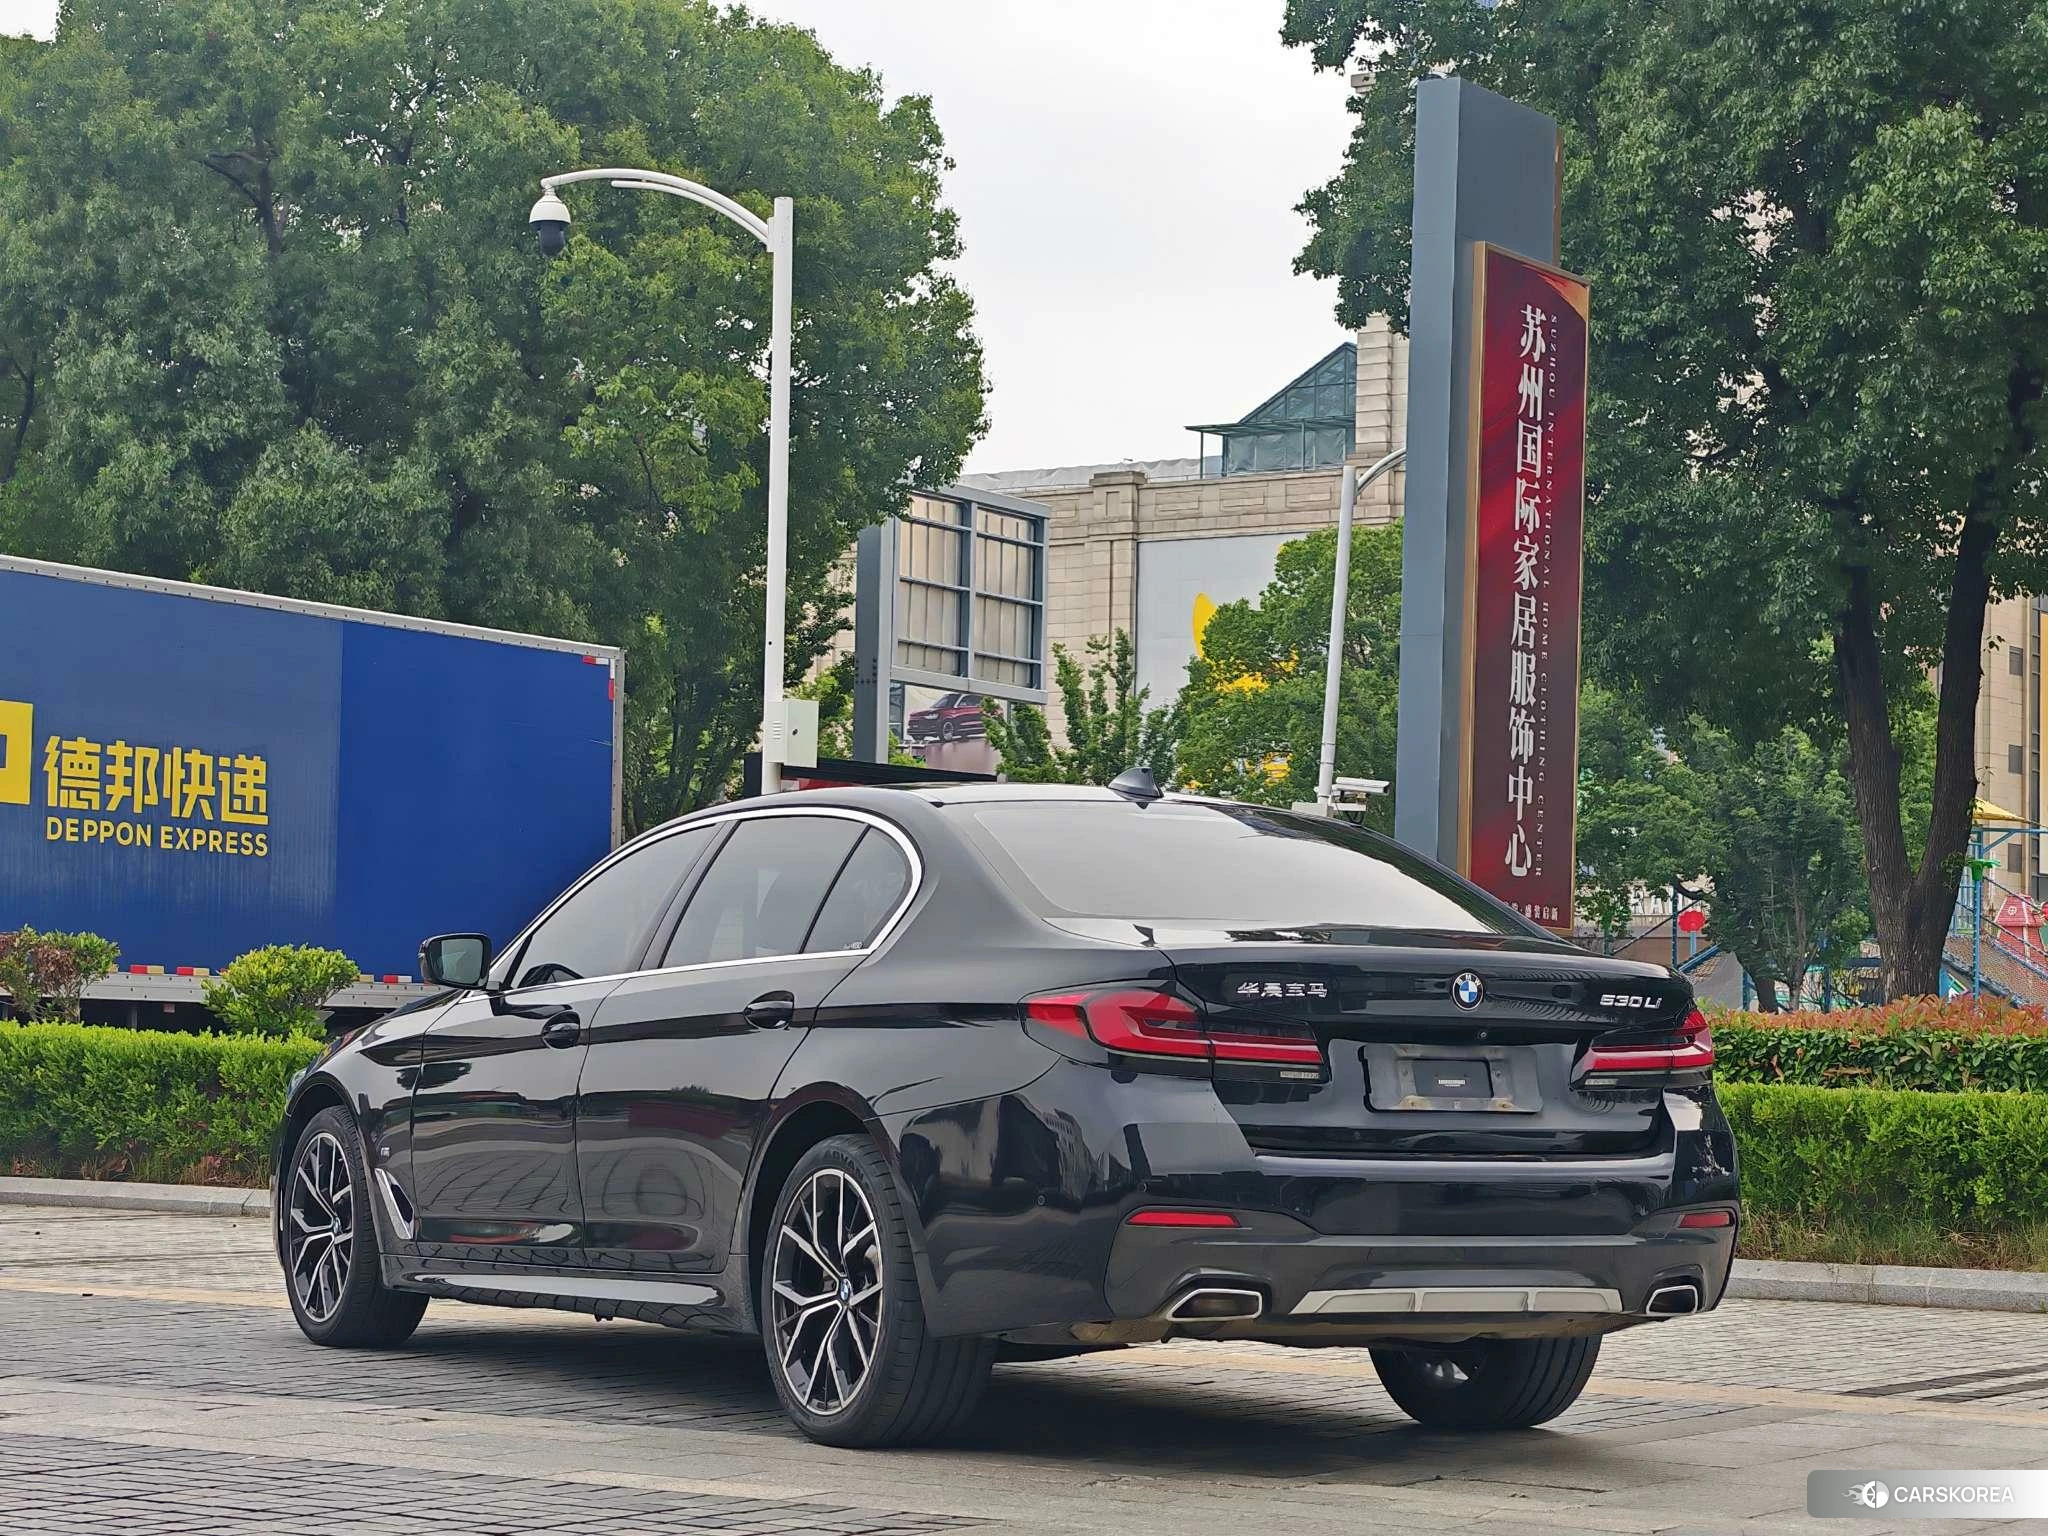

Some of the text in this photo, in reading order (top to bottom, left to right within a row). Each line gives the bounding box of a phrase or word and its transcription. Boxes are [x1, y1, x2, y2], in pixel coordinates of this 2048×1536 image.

[1505, 303, 1547, 877] 苏州国际家居服饰中心
[1535, 314, 1558, 876] SUZHOU INTERNATIONAL HOME CLOTHING CENTER
[43, 735, 269, 826] 德邦快递
[46, 816, 268, 858] DEPPON EXPRESS
[1237, 982, 1328, 998] 华晨宝马
